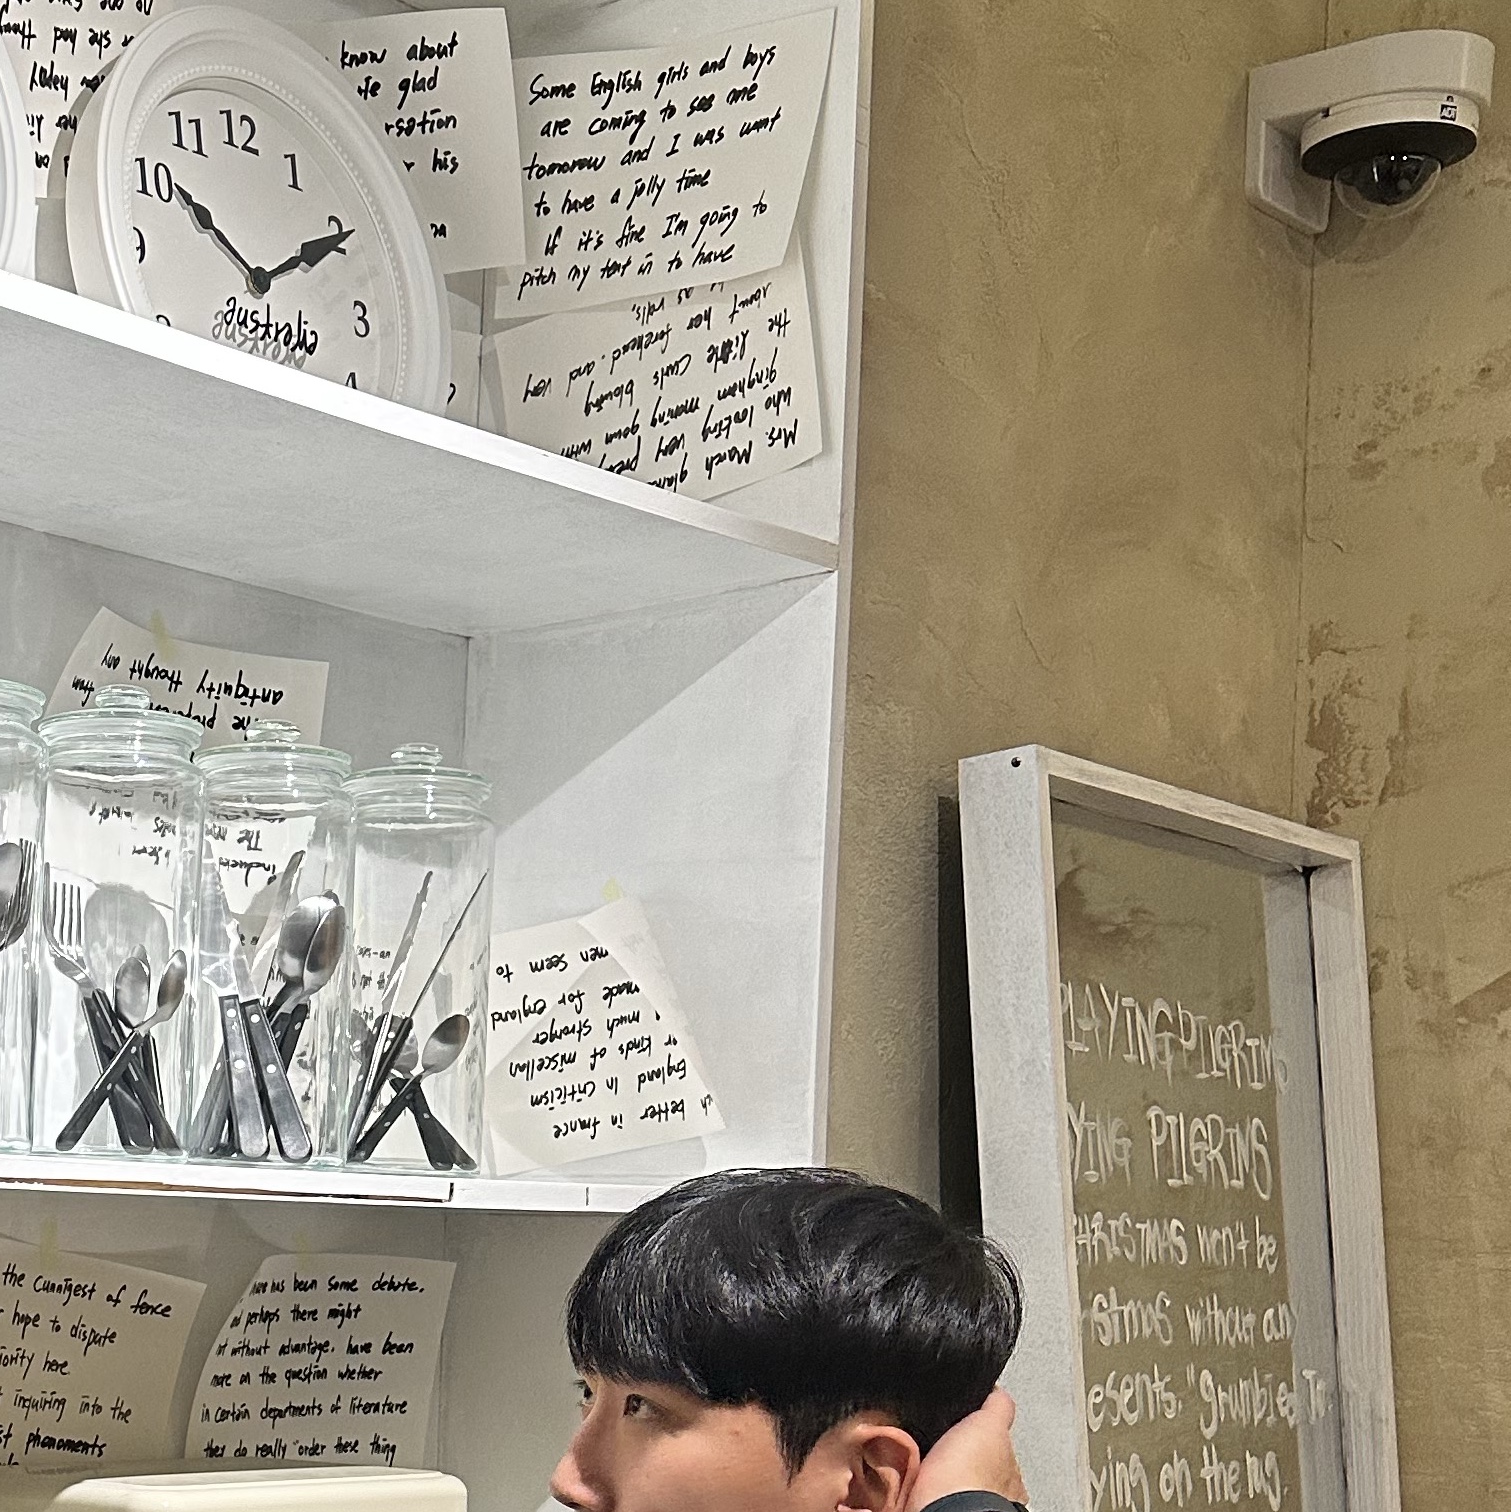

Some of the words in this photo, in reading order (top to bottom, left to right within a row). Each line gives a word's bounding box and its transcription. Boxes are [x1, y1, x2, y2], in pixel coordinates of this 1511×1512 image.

[340, 40, 387, 70] know
[406, 31, 458, 61] about
[397, 65, 439, 110] glad
[529, 74, 576, 105] Some
[591, 70, 642, 110] English
[654, 61, 689, 99] girls
[699, 45, 731, 77] and
[743, 44, 776, 81] boys
[168, 111, 208, 158] 11
[220, 110, 259, 156] 12
[540, 118, 571, 137] are
[588, 109, 647, 145] coming
[660, 99, 676, 123] to
[135, 157, 173, 203] 10
[284, 154, 303, 191] 1
[432, 148, 458, 174] his
[534, 191, 550, 217] to
[561, 189, 594, 214] have
[676, 168, 710, 193] time
[354, 301, 369, 337] 3
[496, 964, 513, 983] to
[611, 1114, 622, 1129] in
[1255, 1215, 1278, 1274] be
[1159, 1448, 1192, 1508] on
[1200, 1443, 1240, 1505] the
